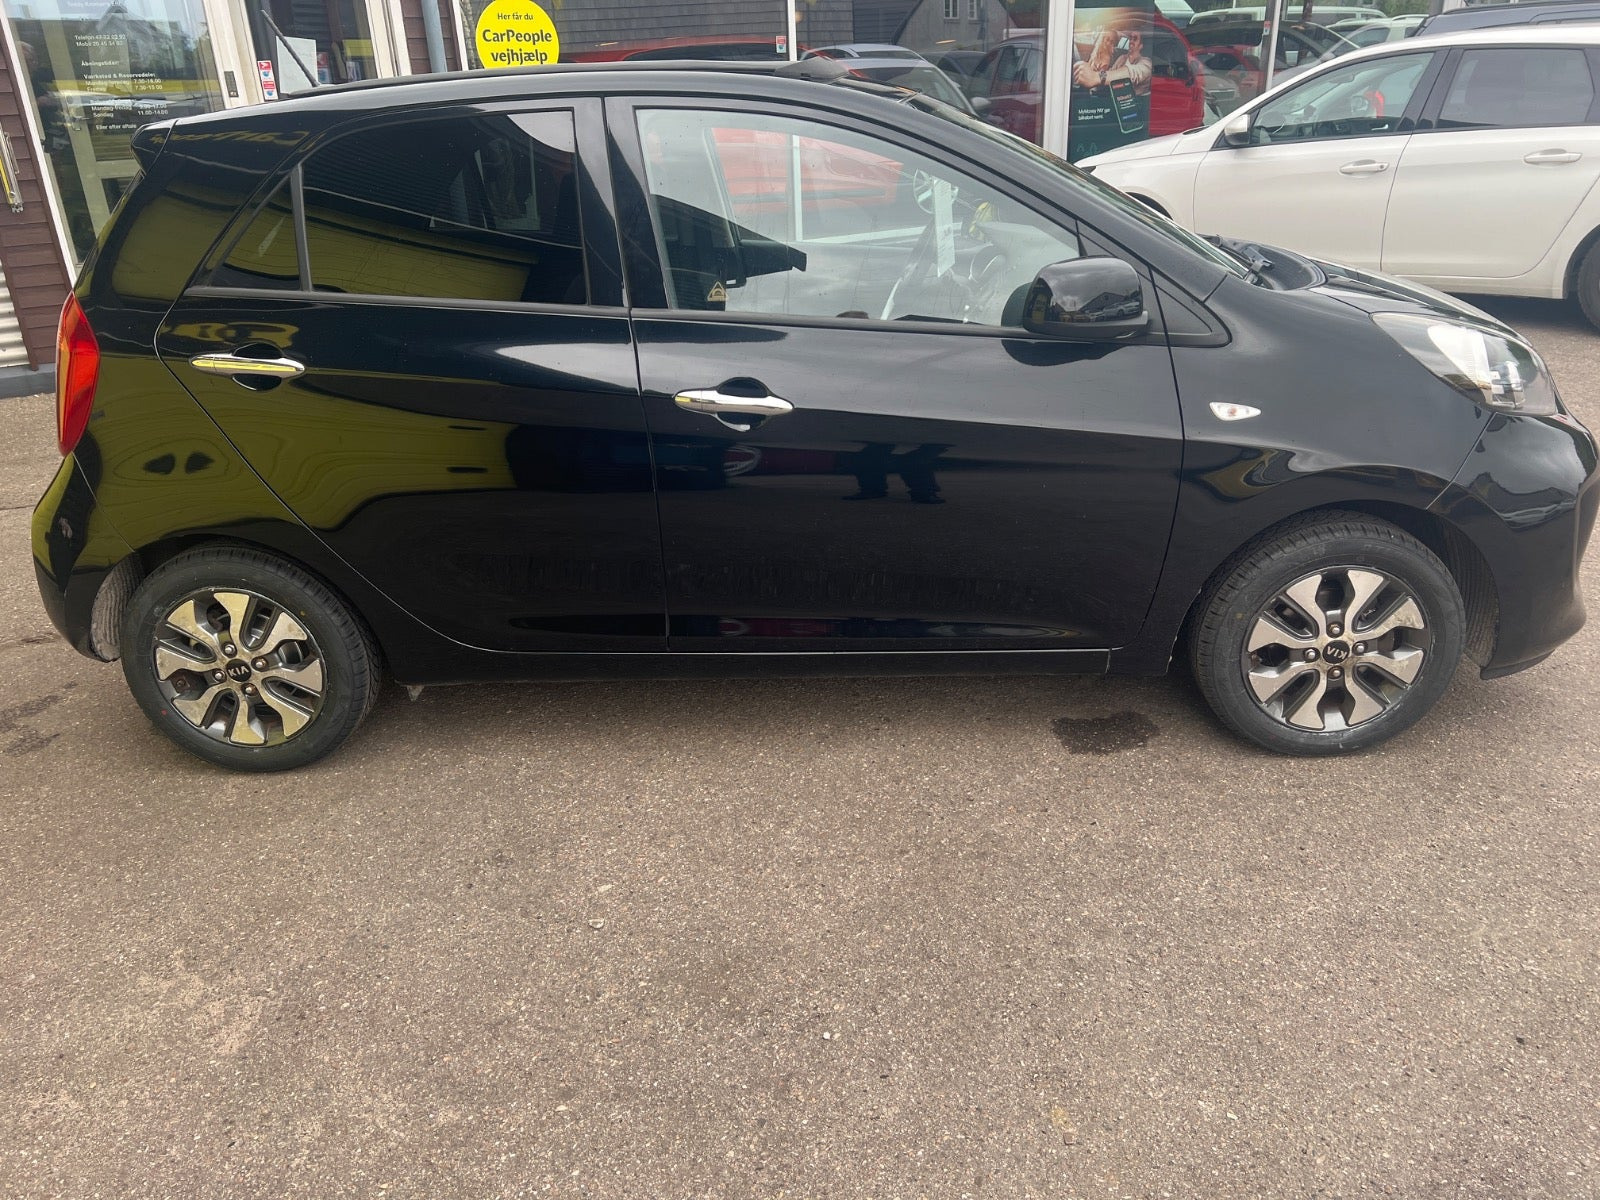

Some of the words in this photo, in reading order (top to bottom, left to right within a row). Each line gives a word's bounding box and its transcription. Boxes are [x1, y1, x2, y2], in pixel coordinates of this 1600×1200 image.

[512, 12, 522, 20] får
[482, 29, 552, 45] CarPeople
[491, 48, 548, 65] vejhjælp
[1327, 646, 1347, 659] KIA
[228, 666, 249, 676] KIA
